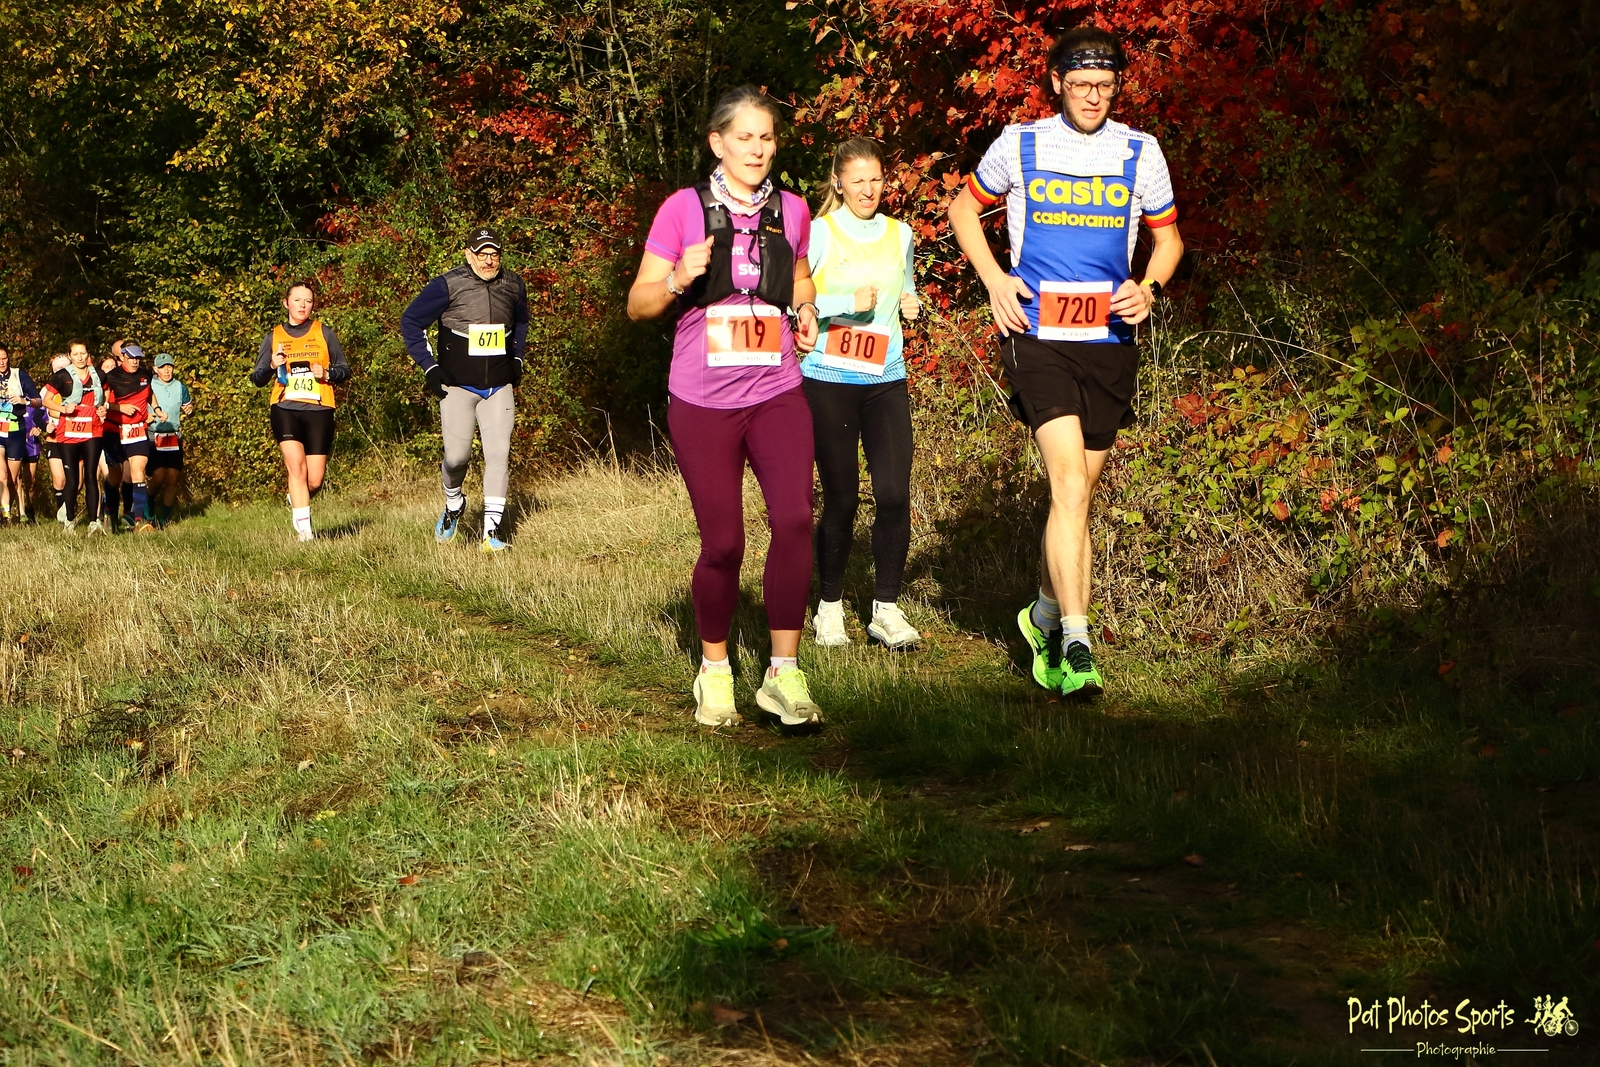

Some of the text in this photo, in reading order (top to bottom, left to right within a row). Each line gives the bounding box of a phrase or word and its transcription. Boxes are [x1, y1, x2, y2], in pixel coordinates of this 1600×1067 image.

[1028, 176, 1130, 207] casto
[1032, 211, 1125, 229] castorama
[1057, 296, 1097, 325] 720
[478, 331, 498, 347] 671
[727, 319, 766, 349] 719
[840, 330, 876, 359] 810
[286, 351, 319, 359] NTERSPORT
[293, 378, 313, 391] 643
[71, 421, 86, 432] 767
